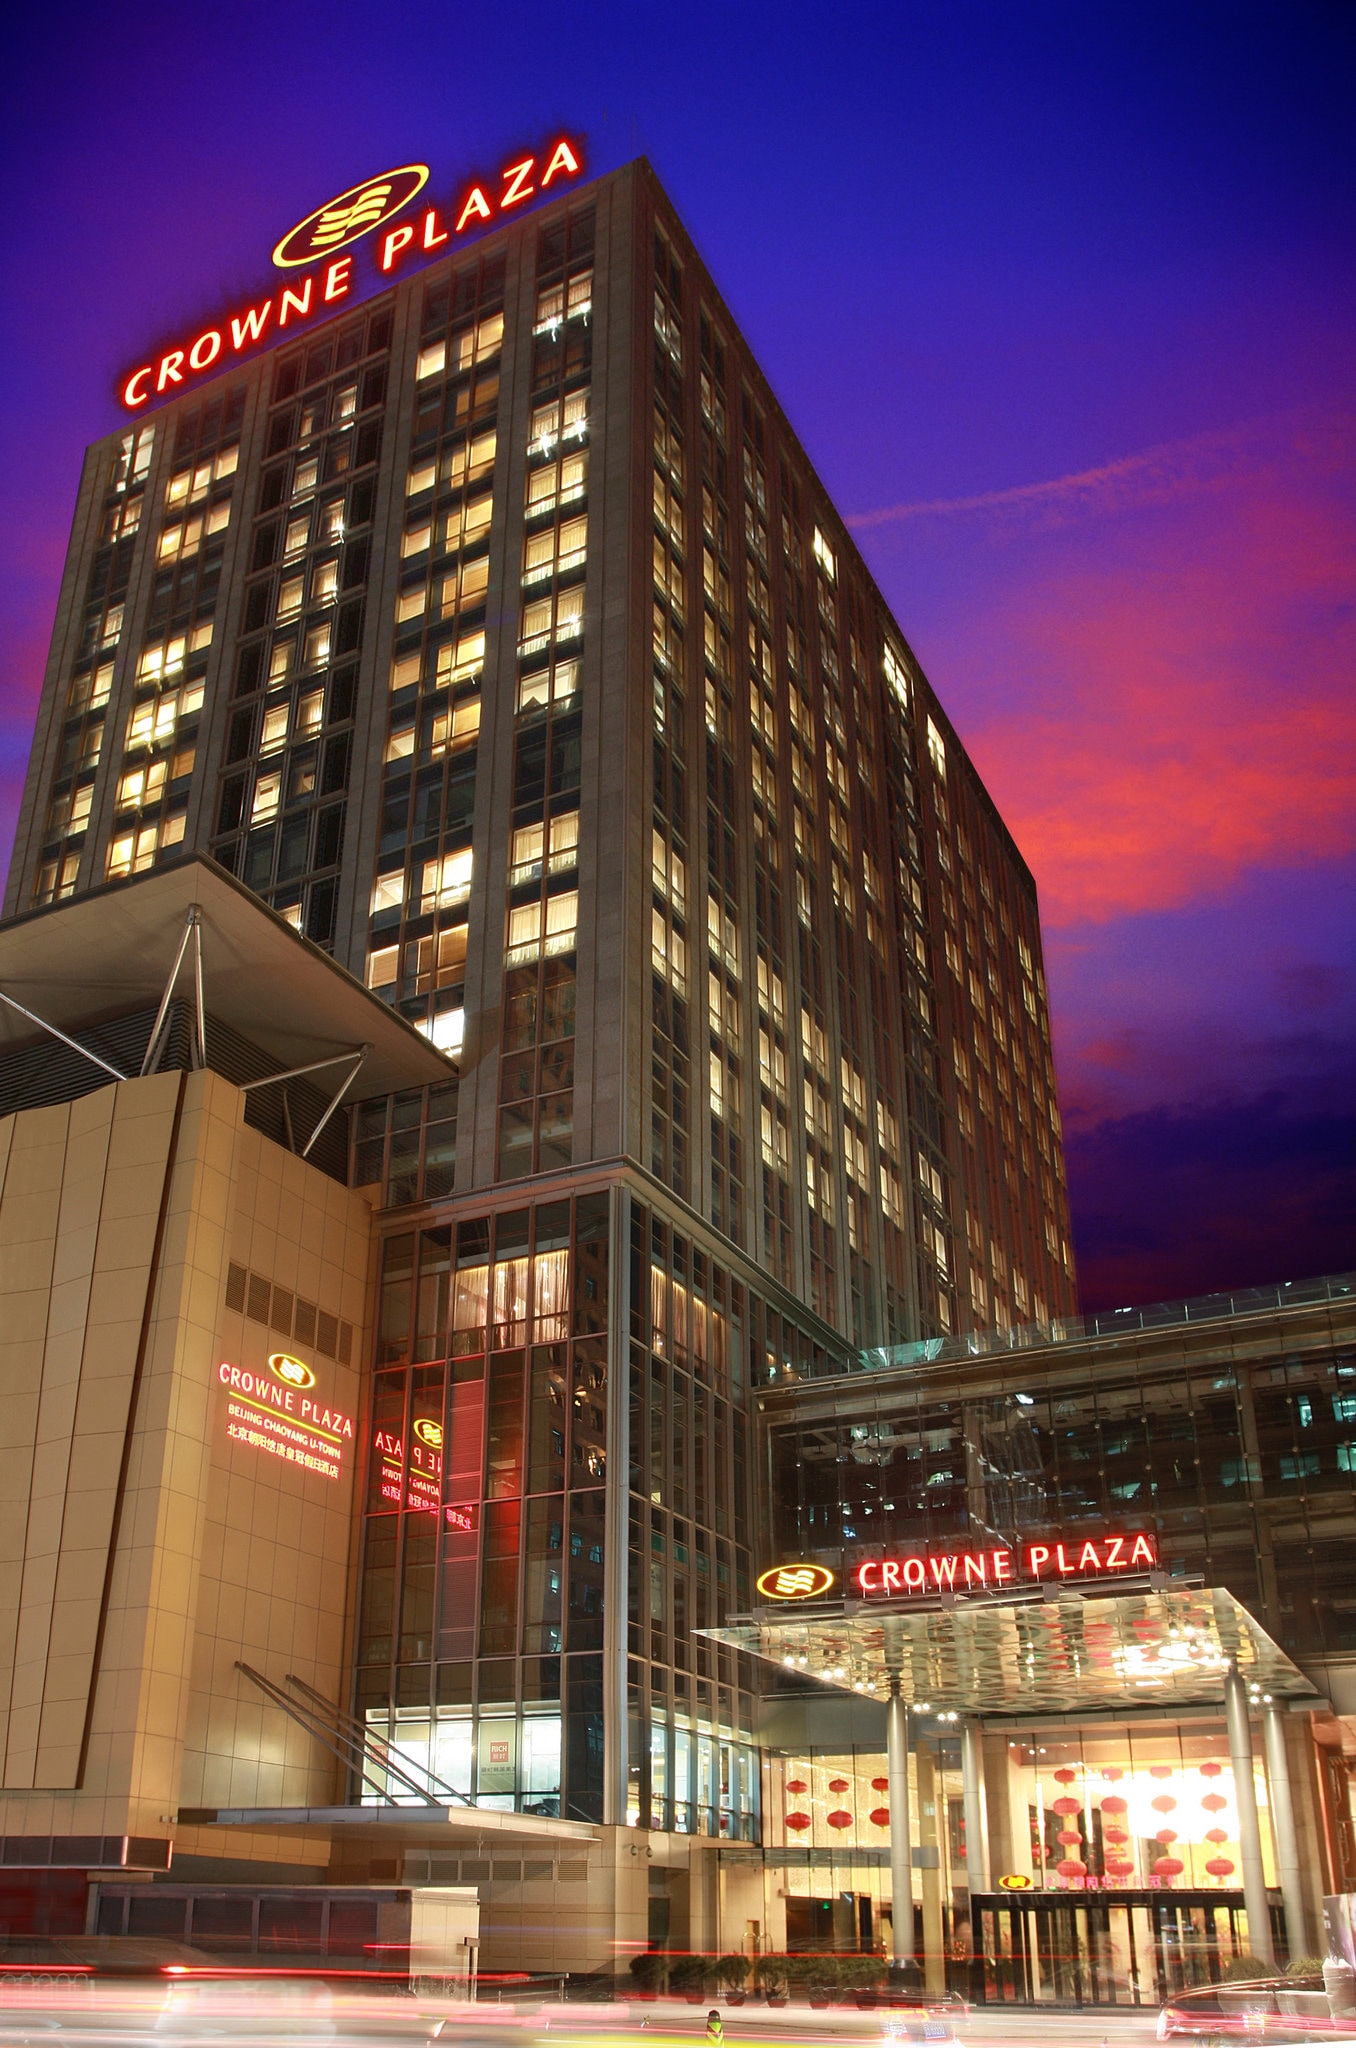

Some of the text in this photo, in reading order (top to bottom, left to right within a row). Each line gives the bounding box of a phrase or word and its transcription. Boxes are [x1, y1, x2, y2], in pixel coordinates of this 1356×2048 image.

[123, 141, 580, 406] CROWNE PLAZA
[219, 1362, 352, 1438] CROWNE PLAZA
[228, 1403, 341, 1460] BEIJING CHAOYANG U-TOWN
[858, 1535, 1155, 1590] CROWNE PLAZA
